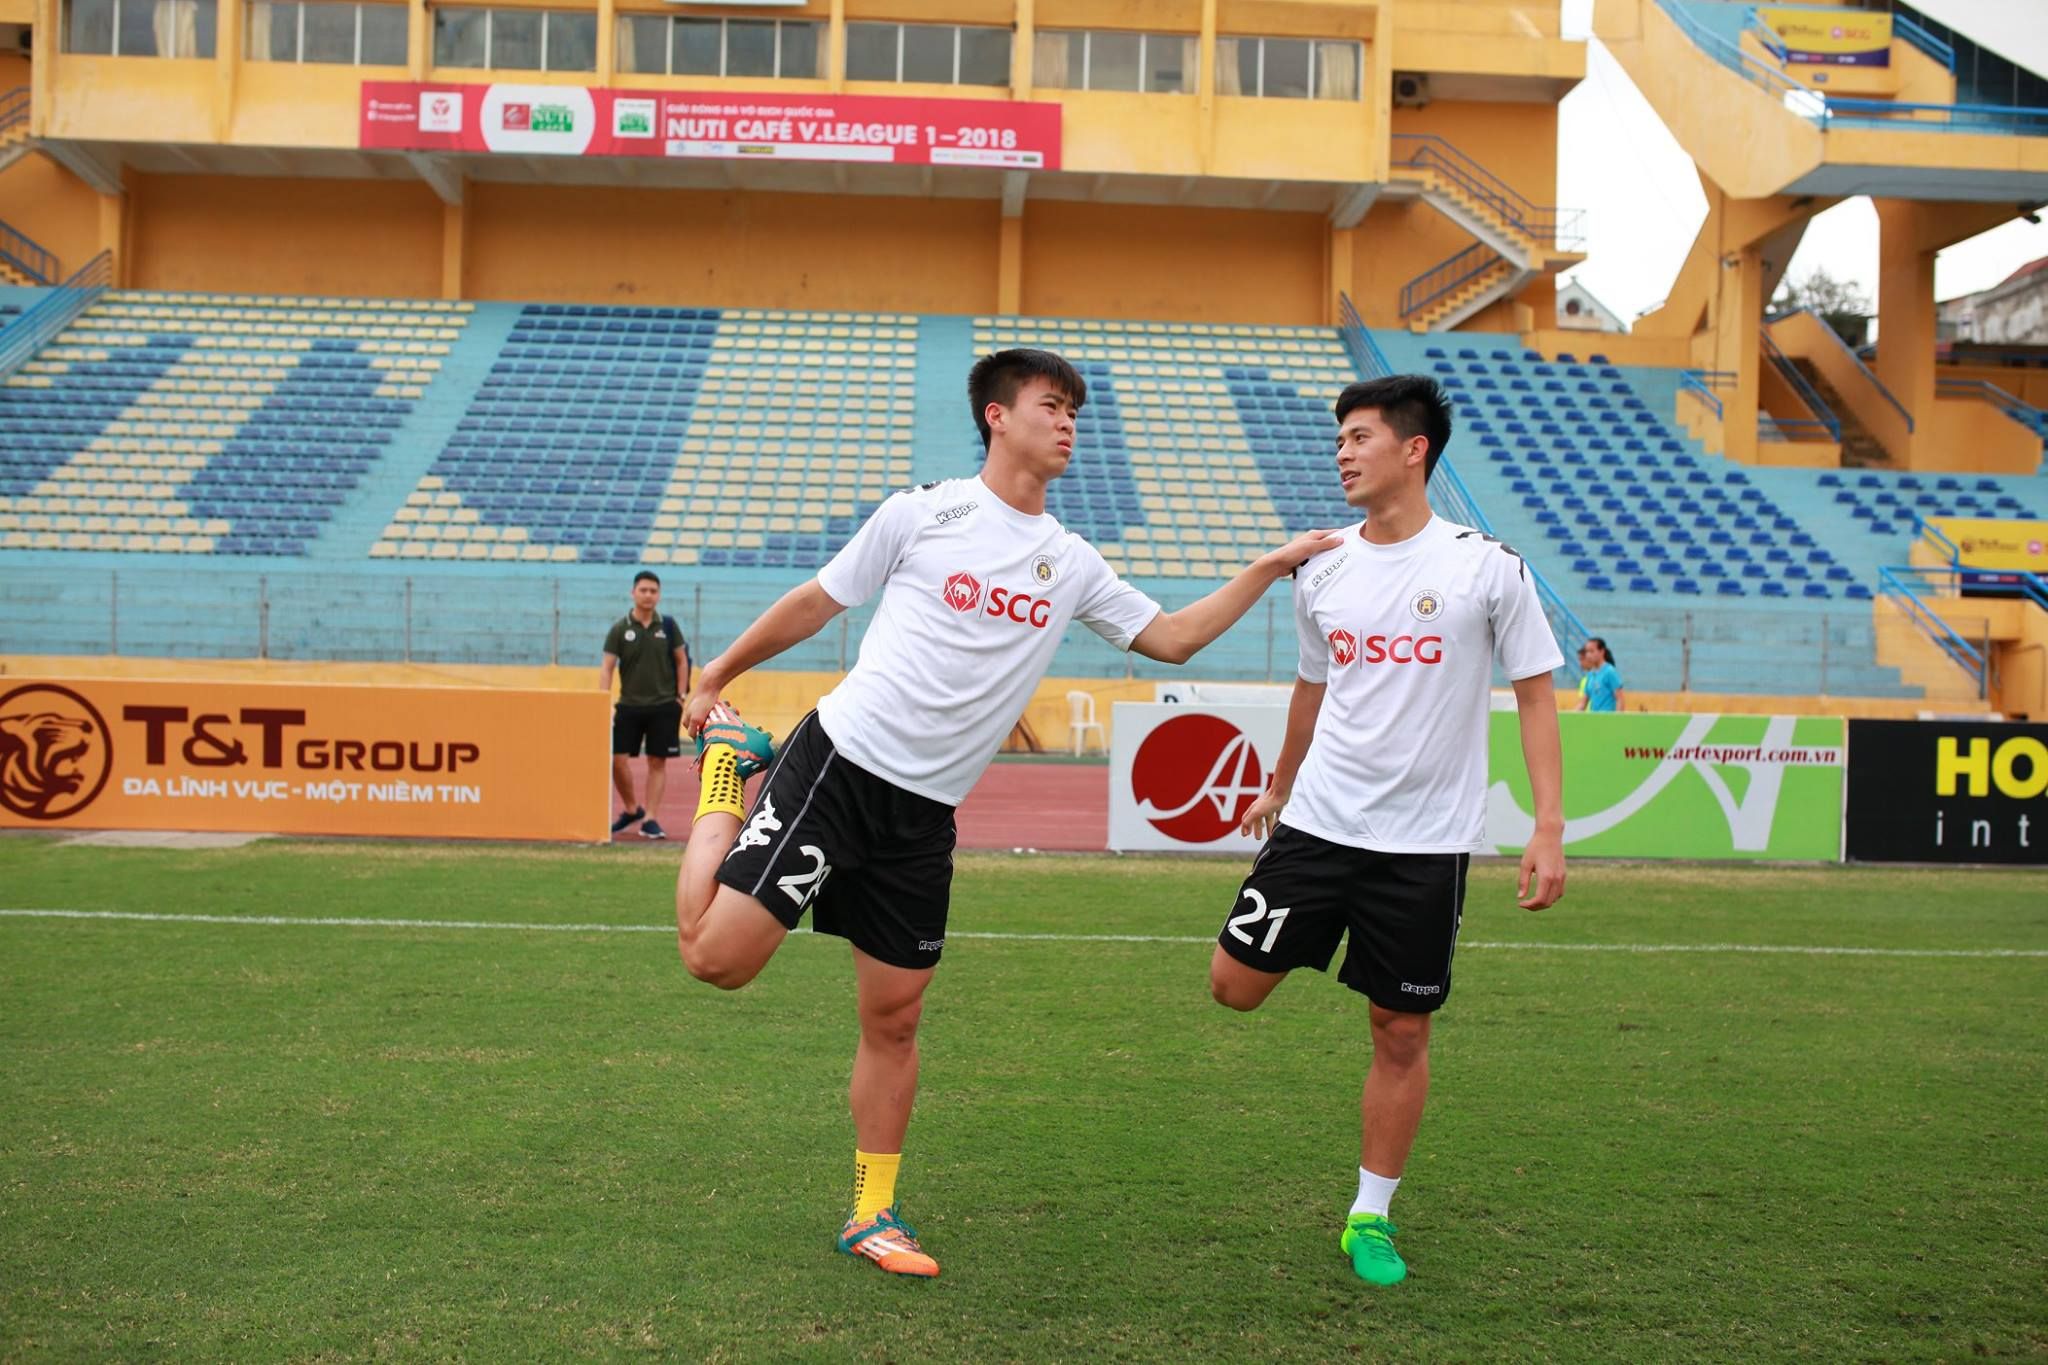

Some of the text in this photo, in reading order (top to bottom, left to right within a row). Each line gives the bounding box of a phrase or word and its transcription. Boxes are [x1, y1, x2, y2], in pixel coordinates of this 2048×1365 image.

[667, 118, 727, 139] NUTI
[733, 117, 793, 140] CAFÉ
[798, 122, 918, 145] V.LEAGUE
[935, 501, 978, 524] Kappa
[986, 587, 1051, 628] SCG
[1366, 635, 1442, 665] SCG
[123, 705, 480, 773] T&T GROUP
[1624, 746, 1836, 765] www.artexport.com.vn
[1937, 735, 2048, 799] HO
[123, 778, 161, 795] ĐA
[306, 779, 362, 804] MỘT
[367, 779, 433, 803] NIỀM
[437, 785, 481, 804] TIN
[1227, 888, 1291, 953] 21
[1401, 982, 1440, 995] Kappa
